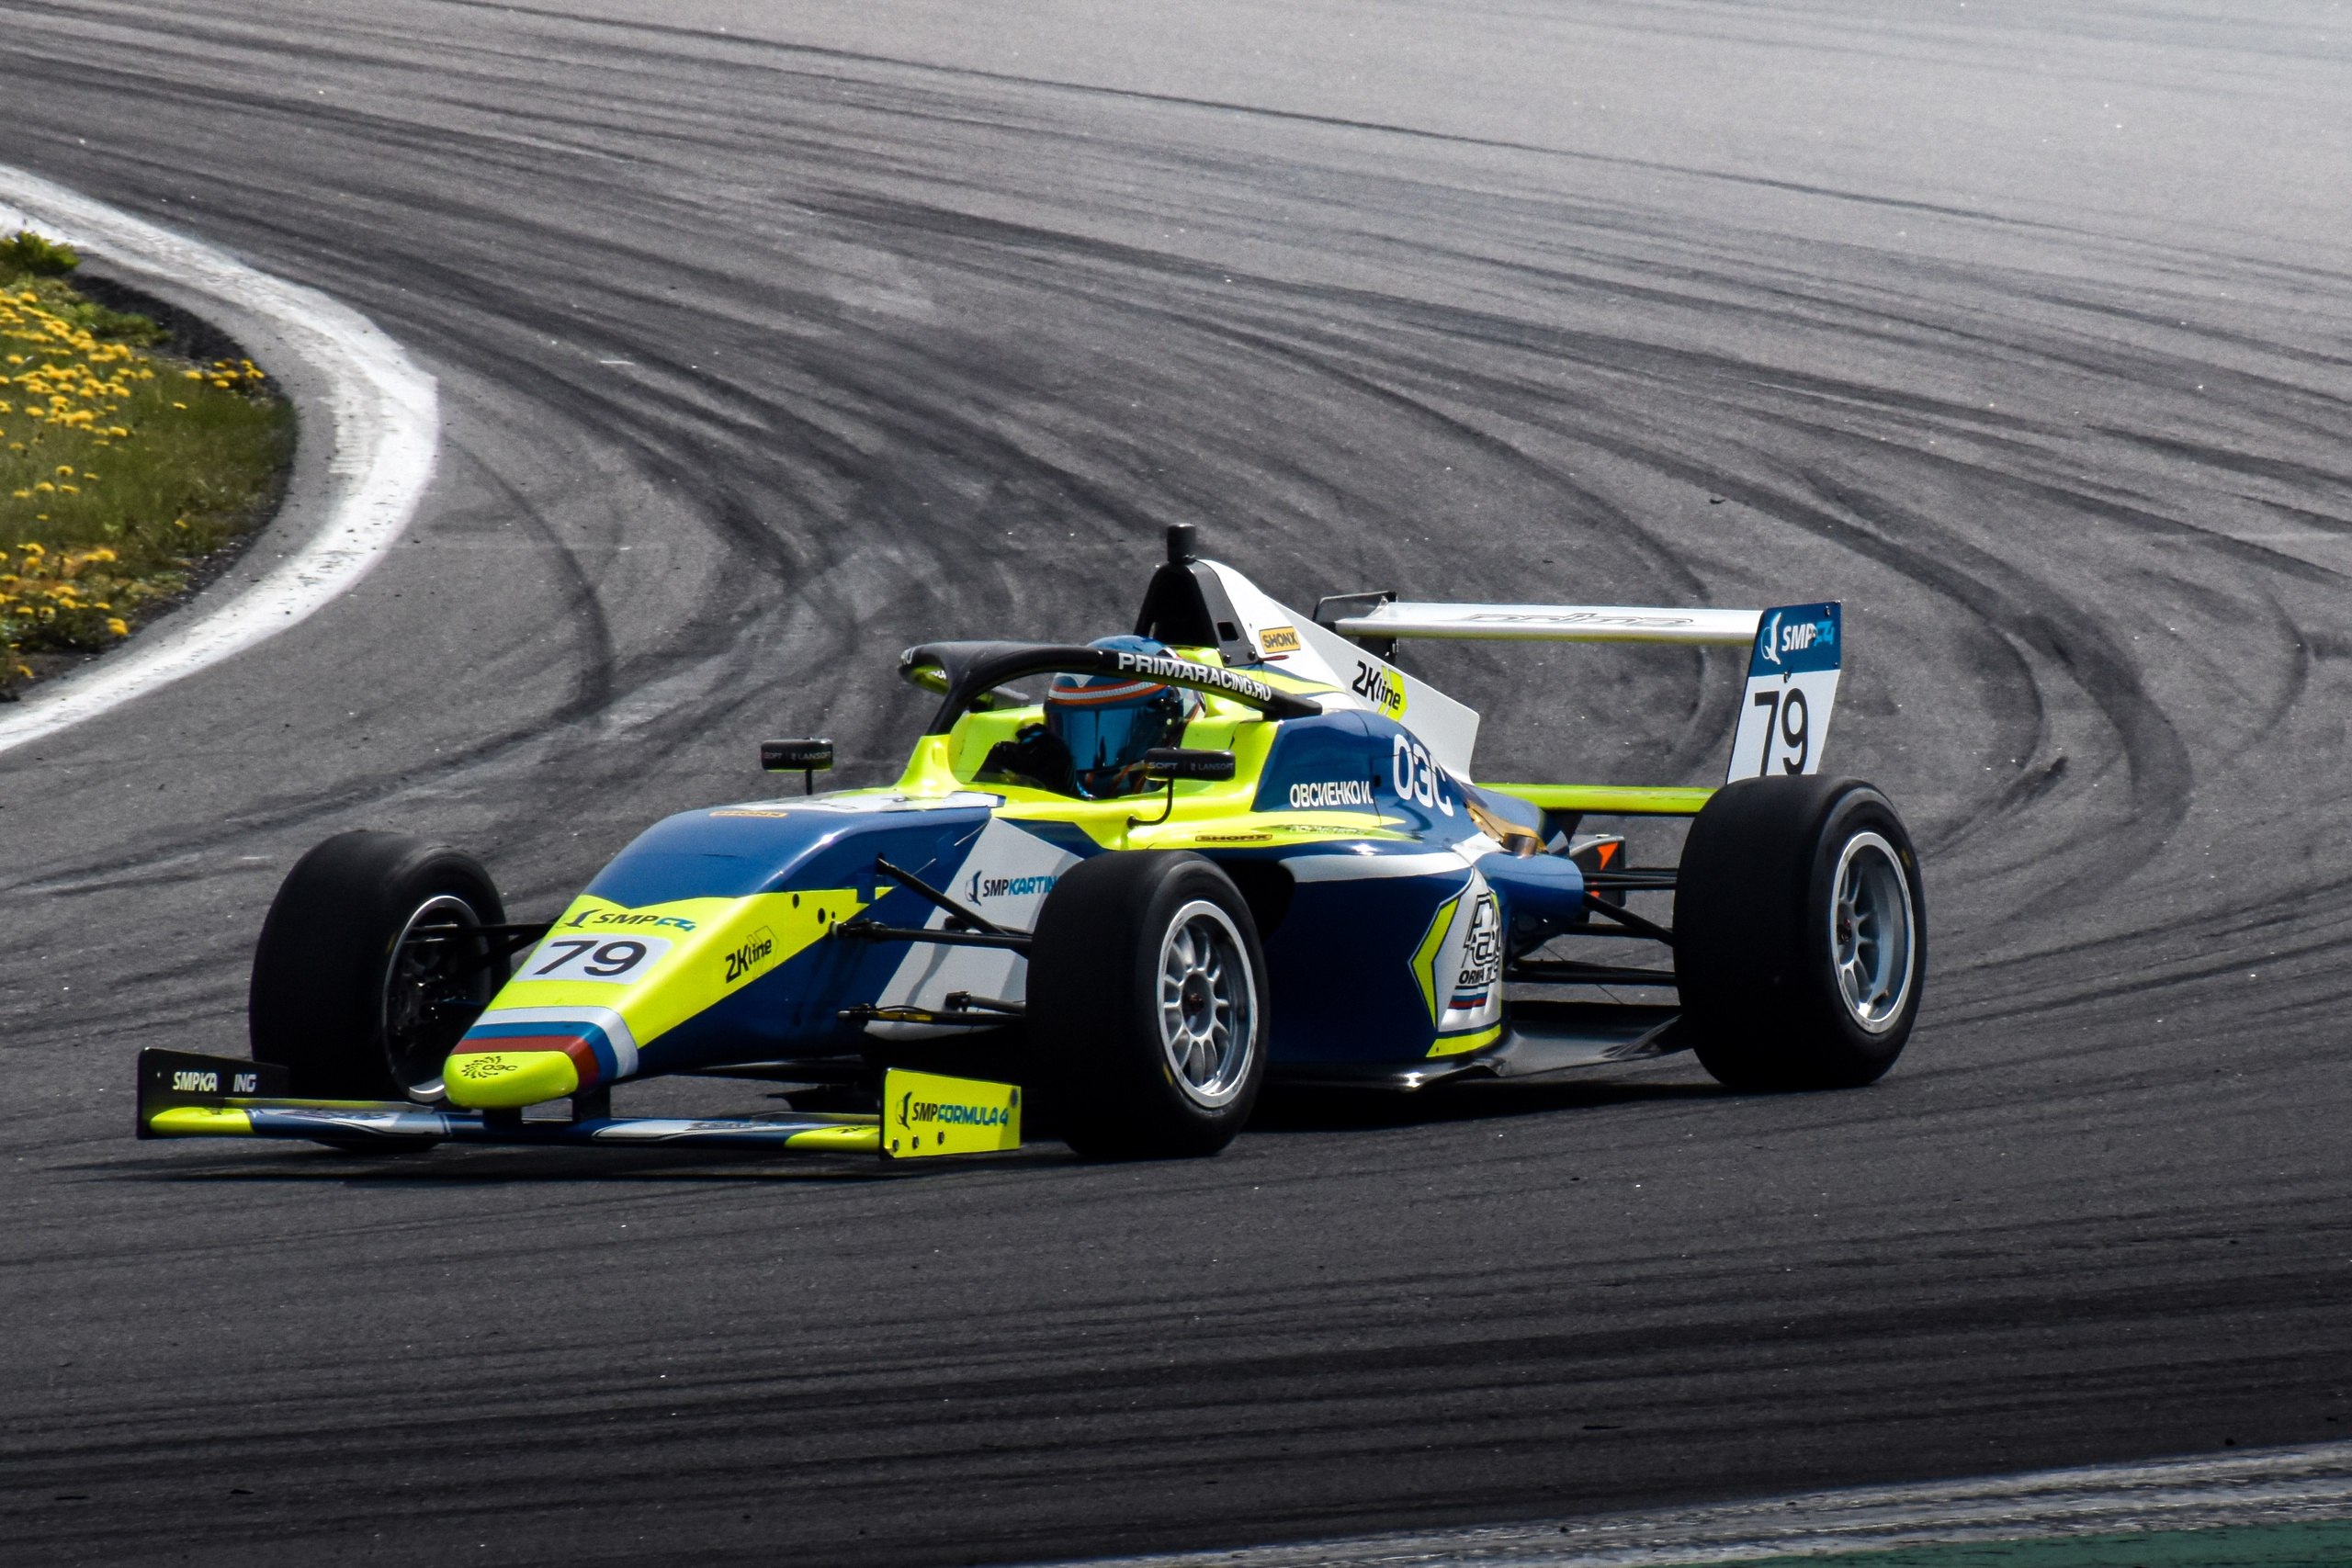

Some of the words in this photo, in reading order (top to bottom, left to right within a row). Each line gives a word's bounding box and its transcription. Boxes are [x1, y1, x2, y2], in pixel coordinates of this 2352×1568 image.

[1262, 631, 1298, 649] SHONX
[1118, 652, 1272, 701] PRIMARACING.RU
[1754, 687, 1809, 776] 79
[982, 875, 1058, 897] SMPKARTIN
[533, 940, 647, 976] 79
